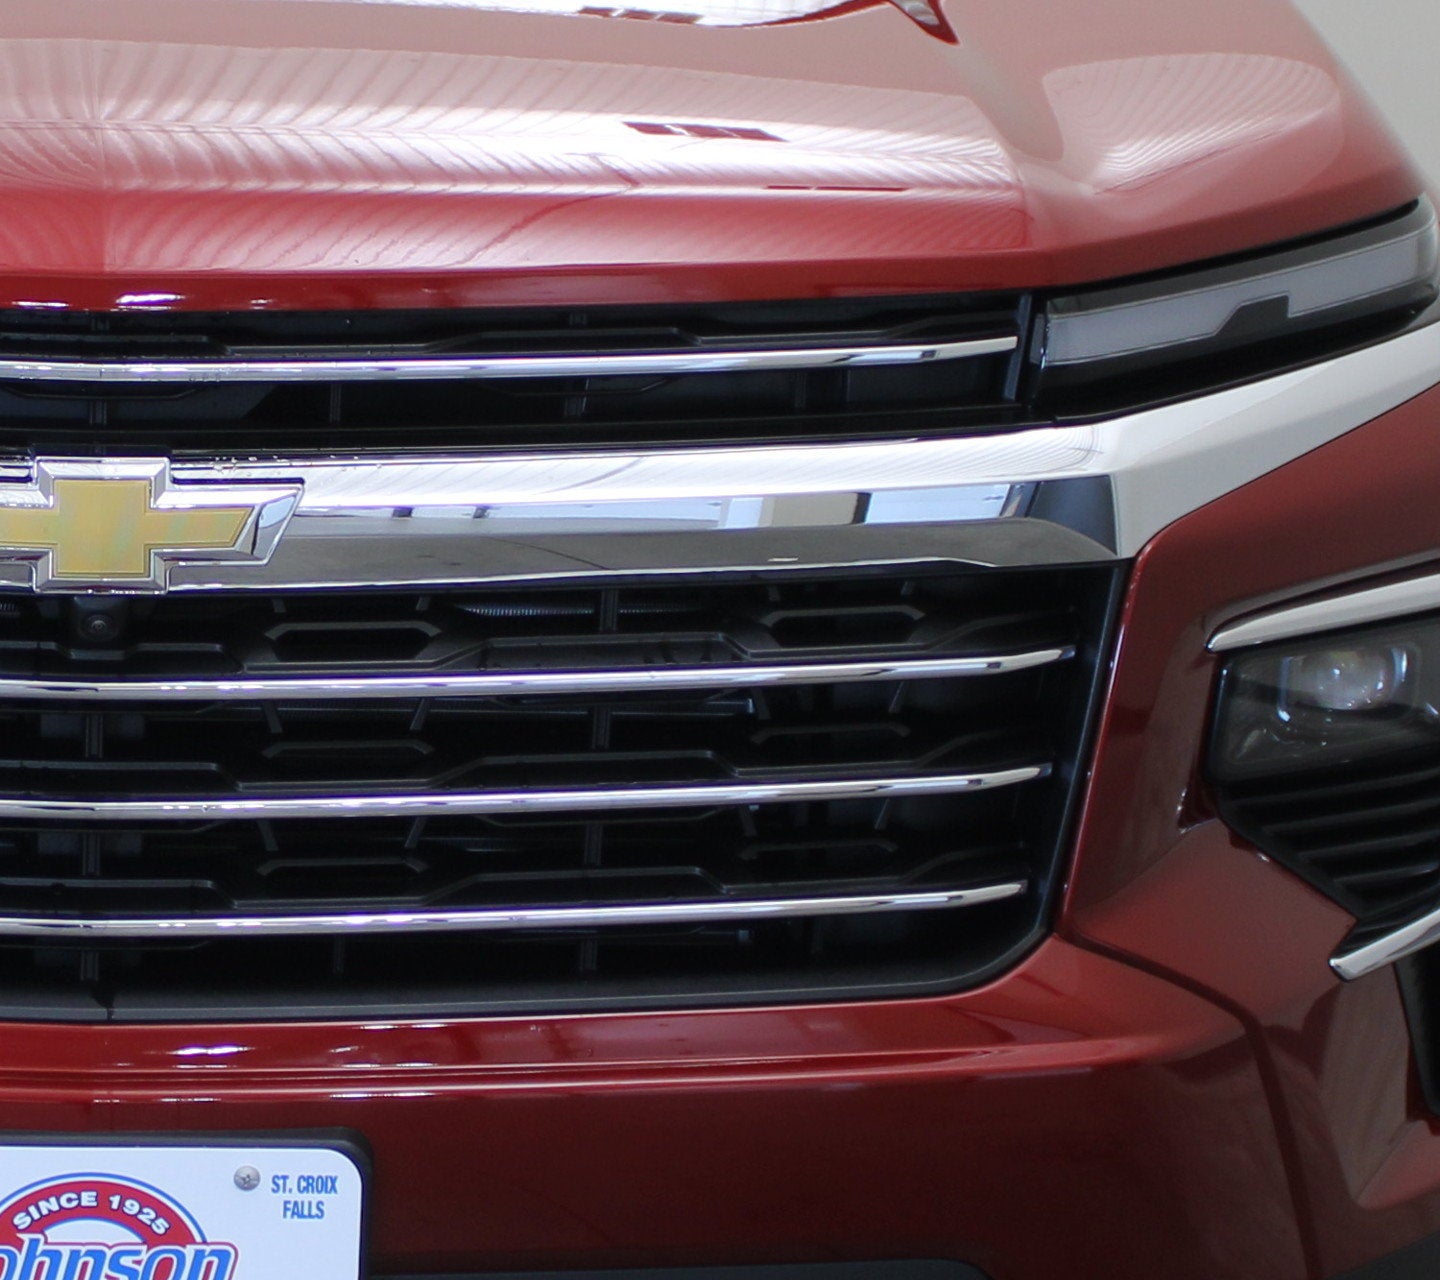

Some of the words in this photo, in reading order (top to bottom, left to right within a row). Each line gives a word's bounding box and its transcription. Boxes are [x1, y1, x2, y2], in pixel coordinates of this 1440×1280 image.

[271, 1174, 293, 1194] ST.
[296, 1175, 338, 1195] CROIX
[13, 1190, 99, 1231] SINCE
[108, 1193, 172, 1236] 1925
[282, 1200, 325, 1220] FALLS
